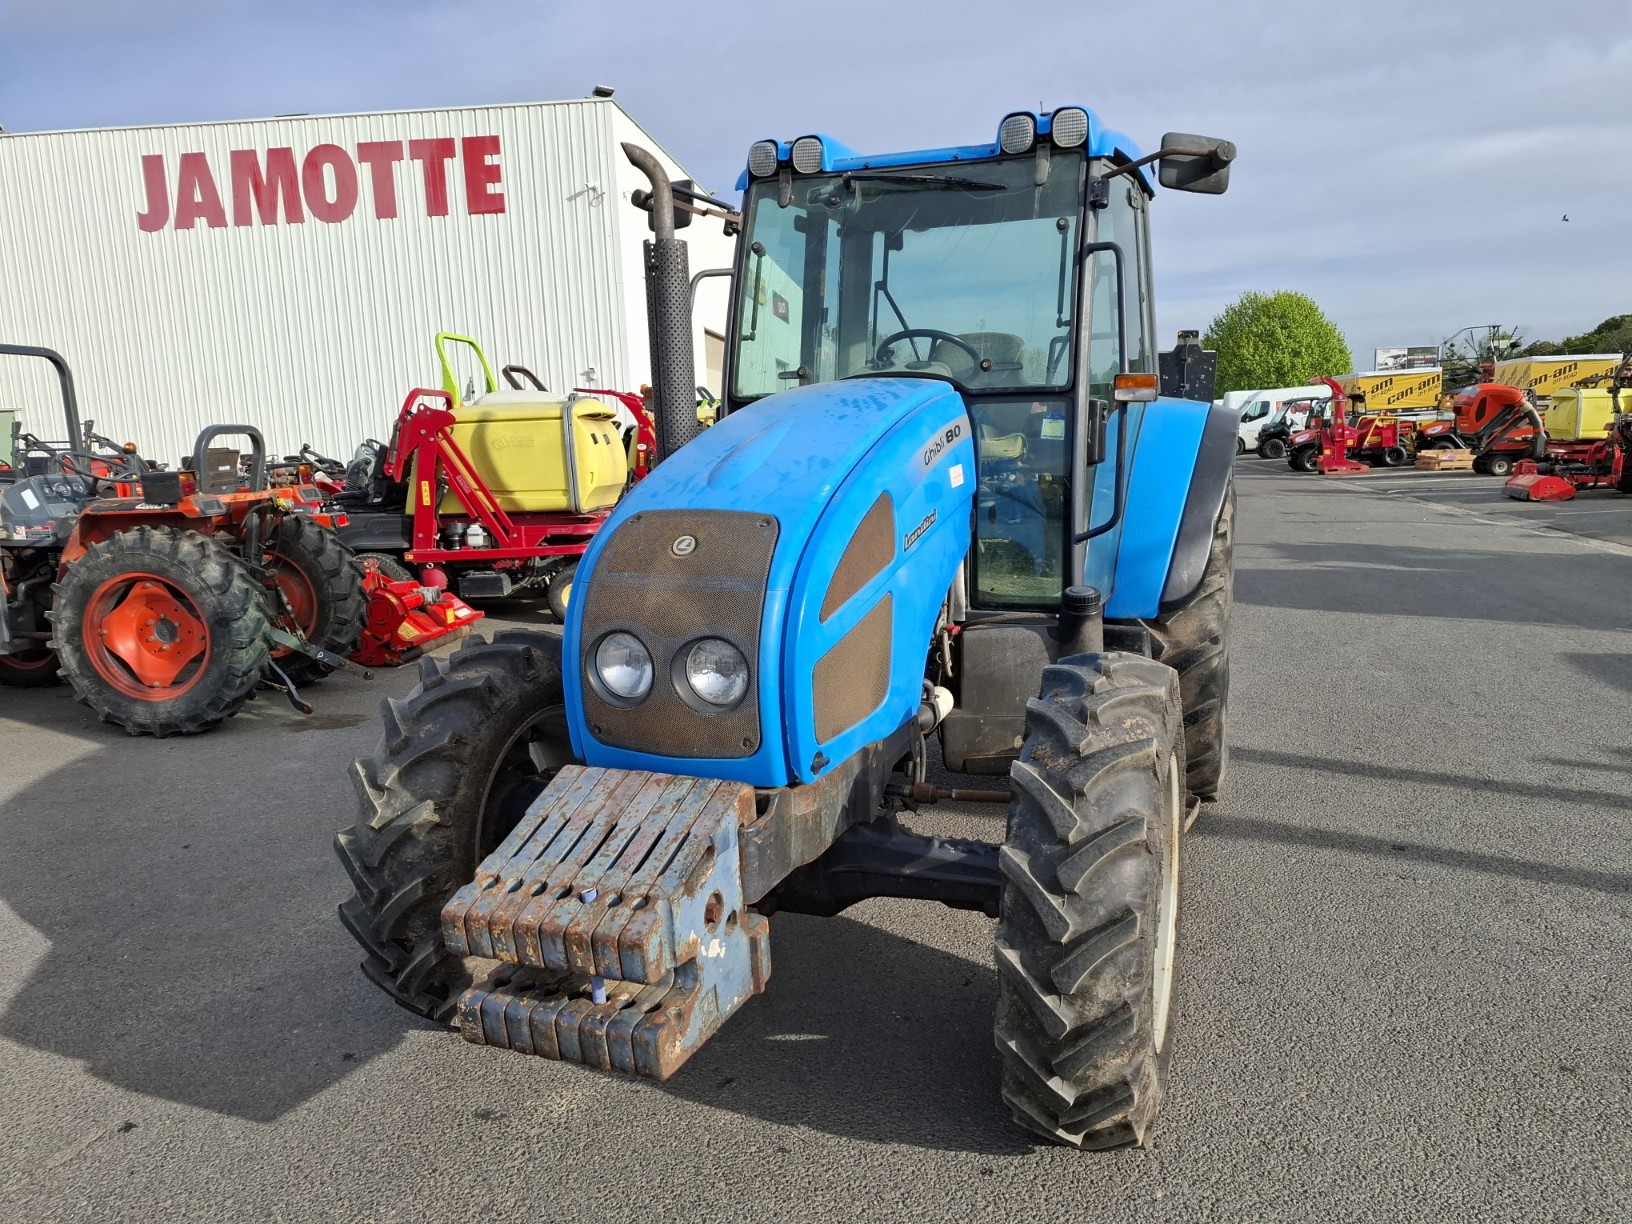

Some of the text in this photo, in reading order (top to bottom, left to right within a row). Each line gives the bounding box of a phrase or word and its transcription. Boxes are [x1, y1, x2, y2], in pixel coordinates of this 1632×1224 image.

[137, 135, 505, 232] JAMOTTE
[1388, 374, 1440, 405] can-am
[924, 424, 961, 466] Ghibli 80
